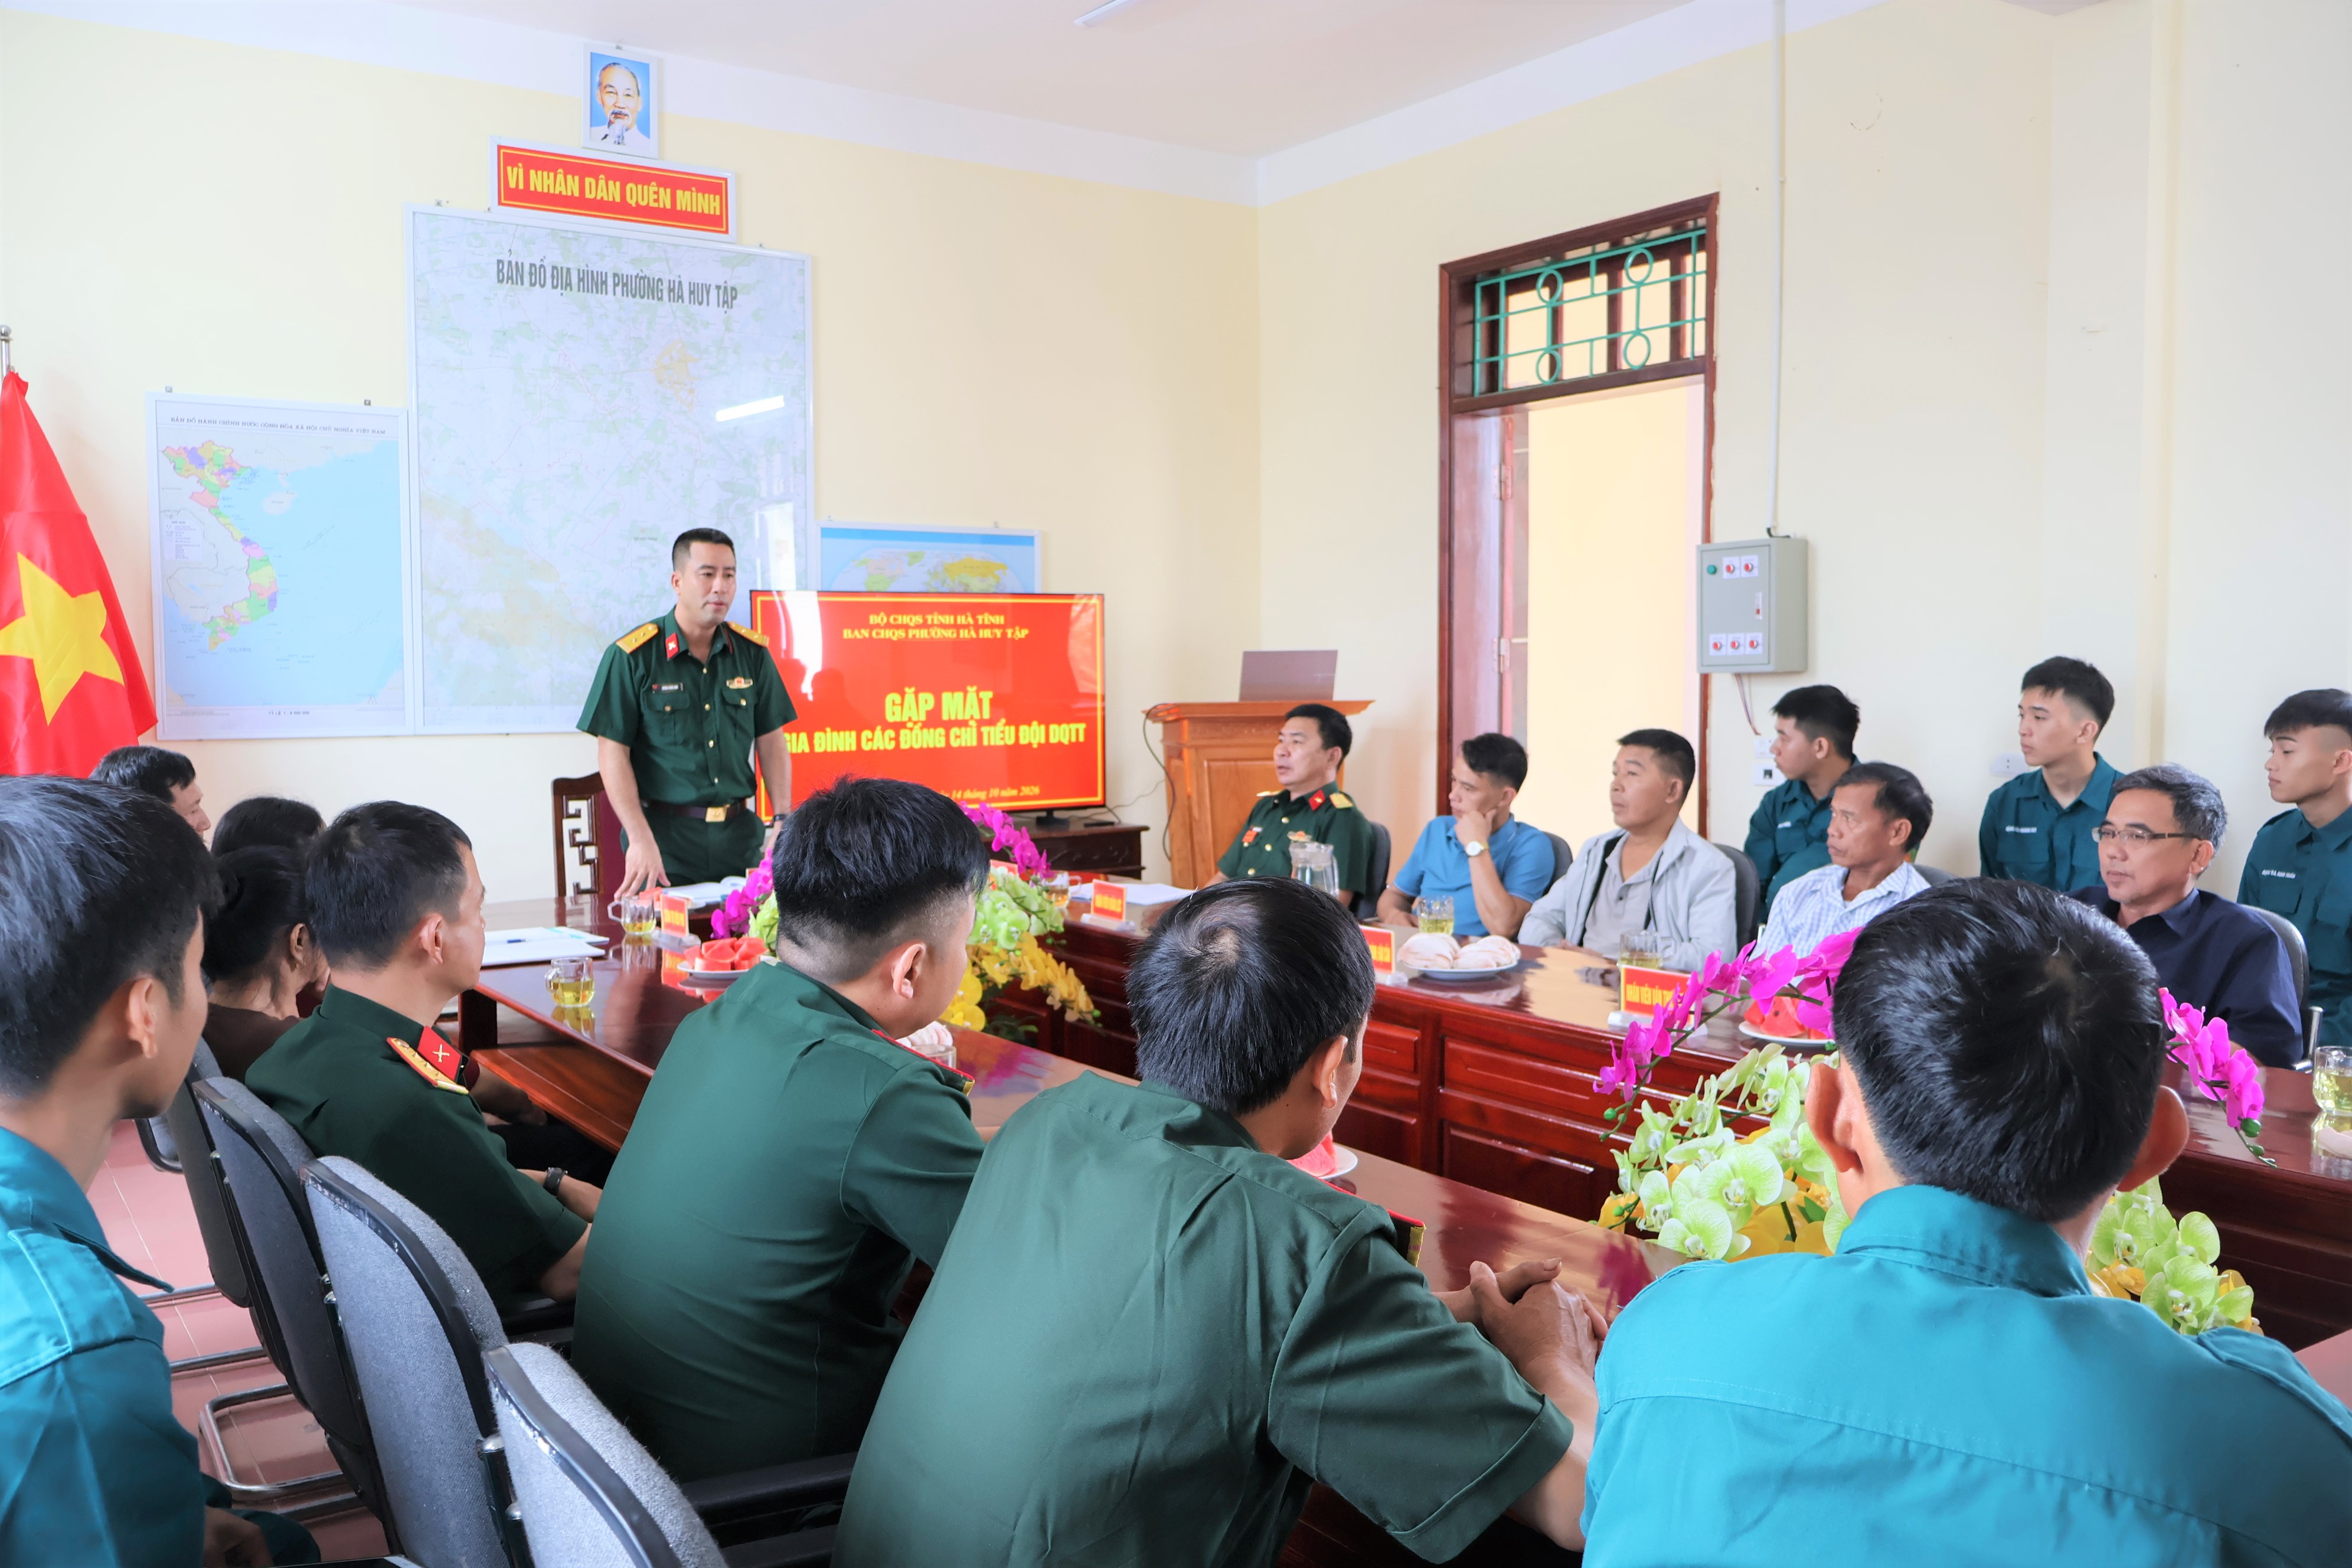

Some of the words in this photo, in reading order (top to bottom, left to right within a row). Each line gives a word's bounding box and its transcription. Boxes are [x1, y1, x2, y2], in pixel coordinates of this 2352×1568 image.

[507, 163, 524, 190] VÌ
[529, 169, 580, 198] NHÂN
[584, 175, 621, 202] DÂN
[626, 182, 671, 209] QUÊN
[676, 187, 720, 215] MÌNH
[496, 249, 524, 286] BẢN
[528, 256, 547, 289] ĐỒ
[551, 266, 573, 296] ĐỊA
[577, 264, 608, 295] HÌNH
[613, 269, 664, 302] PHƯỜNG
[668, 274, 684, 304] HÀ
[688, 282, 711, 306] HUY
[716, 280, 738, 314] TẬP
[843, 628, 870, 639] BAN
[871, 628, 906, 641] CHQS
[908, 626, 957, 639] PHƯỜNG
[959, 625, 976, 638] HÀ
[978, 628, 1003, 638] HUY
[1005, 625, 1029, 641] TẬP
[869, 611, 887, 626] BỘ
[889, 614, 923, 626] CHQS
[925, 612, 955, 625] TỈNH
[956, 612, 974, 625] HÀ
[976, 612, 1005, 625] TĨNH
[885, 687, 935, 727] GẶP
[942, 685, 993, 726] MẶT
[814, 727, 857, 752] ĐÌNH
[861, 726, 896, 751] CÁC
[899, 723, 946, 749] ĐỒNG
[981, 718, 1015, 746] TIỂU
[1019, 721, 1046, 748] ĐỘI
[1048, 723, 1087, 745] DQTT
